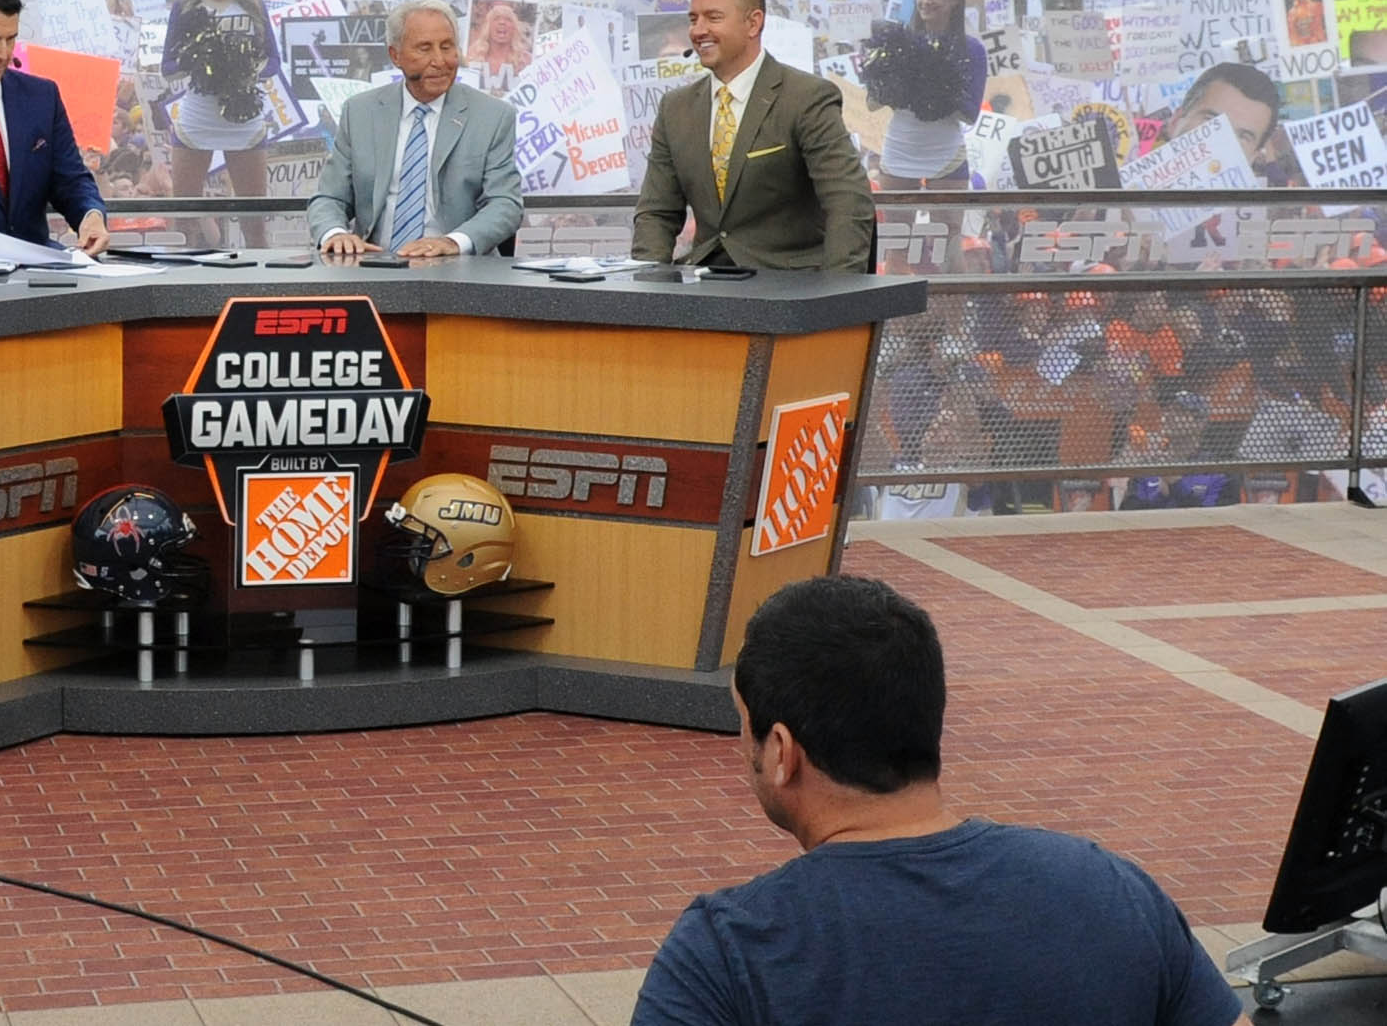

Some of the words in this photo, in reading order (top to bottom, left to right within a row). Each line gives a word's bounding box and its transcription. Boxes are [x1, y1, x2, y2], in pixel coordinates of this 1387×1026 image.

[340, 19, 386, 42] VAD
[981, 29, 1009, 54] I
[1179, 18, 1221, 50] WE
[629, 64, 657, 80] THE
[988, 51, 1021, 77] ike
[1280, 46, 1342, 77] WOO!
[1289, 119, 1327, 145] HAVE
[1328, 106, 1370, 136] YOU
[267, 164, 296, 183] YOU
[298, 158, 326, 180] AIN
[1034, 143, 1098, 179] OUTTA
[1119, 149, 1164, 184] DANNY
[1169, 119, 1223, 153] ROCCO'S
[1141, 142, 1212, 189] DAUGHTER
[1311, 135, 1367, 177] SEEN
[877, 222, 949, 264] PN
[1020, 220, 1166, 263] ESPN
[253, 308, 349, 335] ESPN
[215, 349, 383, 389] COLLEGE
[190, 396, 415, 449] GAMEDAY
[270, 456, 307, 471] BUILT
[308, 456, 328, 471] BY
[780, 417, 810, 476] THE
[486, 444, 669, 509] ESPN
[758, 399, 846, 549] HOME
[256, 486, 302, 529] THE
[438, 499, 502, 526] JMU
[788, 453, 841, 543] DEPOT
[245, 474, 352, 582] HOME
[283, 513, 352, 582] DEPOT
